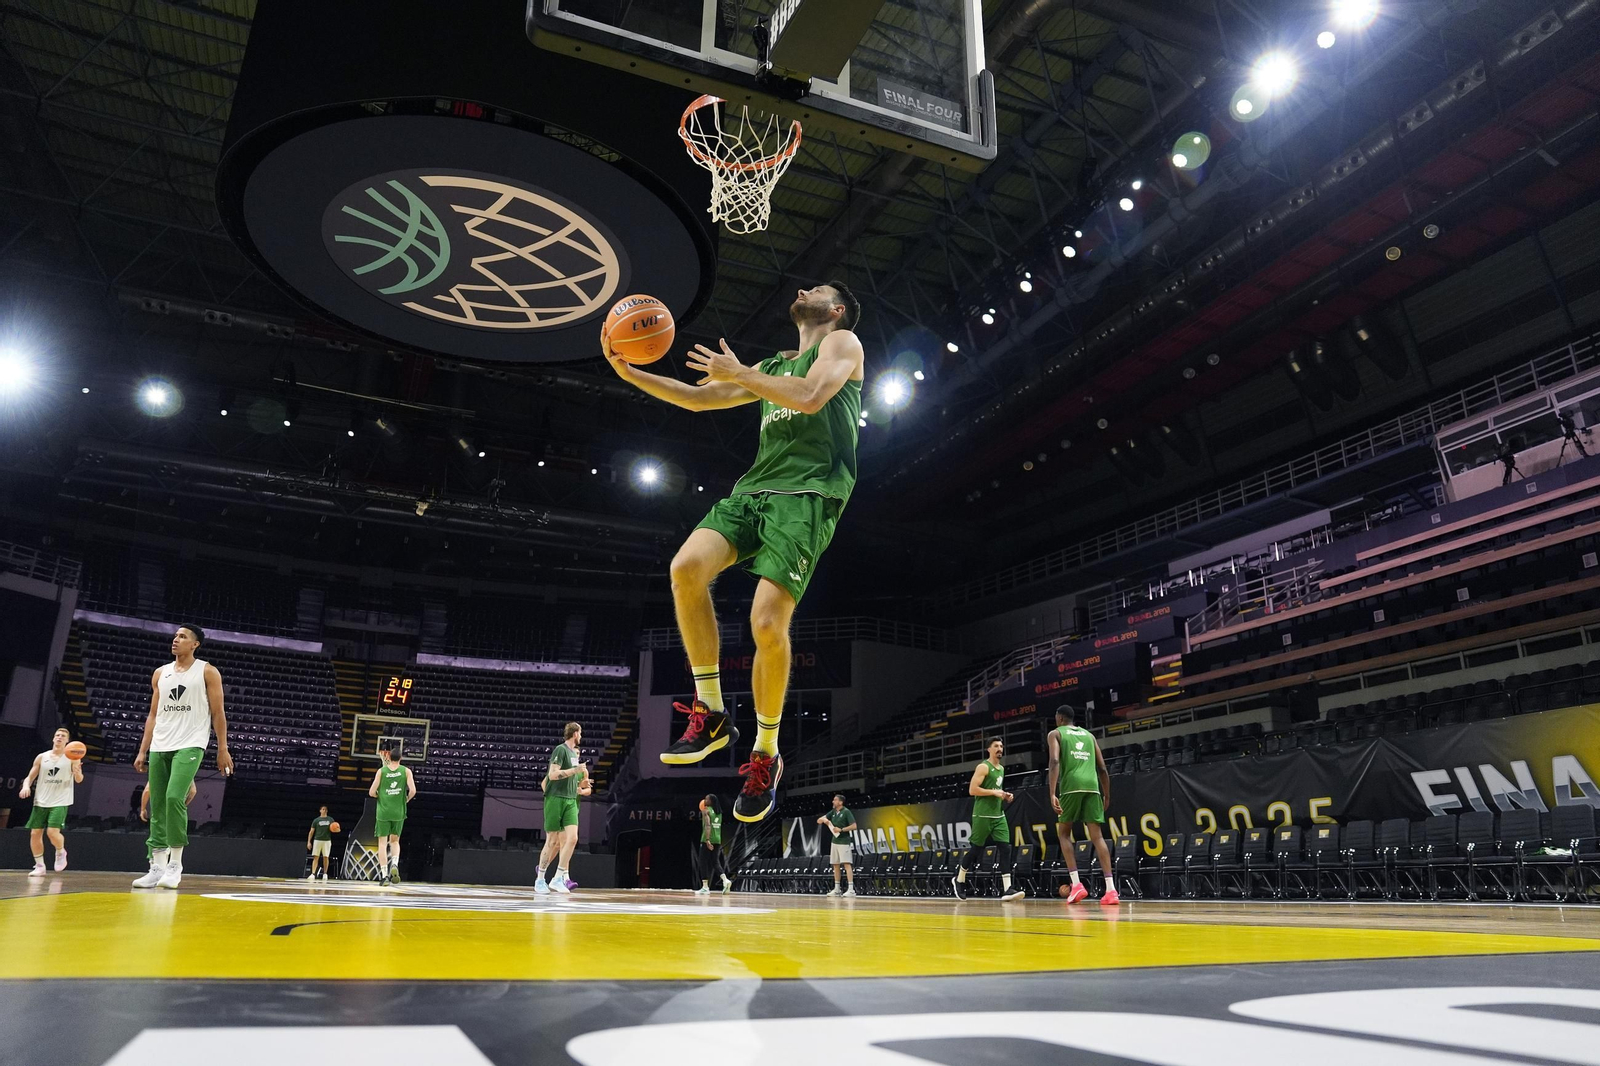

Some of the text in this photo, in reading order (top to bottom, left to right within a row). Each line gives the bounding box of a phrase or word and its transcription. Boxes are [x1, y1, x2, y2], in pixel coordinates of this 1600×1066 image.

[883, 88, 963, 121] FINAL FOUR
[614, 298, 660, 316] Wilson
[1153, 606, 1171, 617] arena
[1120, 630, 1138, 641] arena
[1083, 655, 1101, 667] arena
[1061, 676, 1078, 688] arena
[383, 688, 408, 704] 24
[1019, 704, 1036, 715] arena
[1410, 755, 1600, 816] FINA
[906, 822, 972, 852] FOUR
